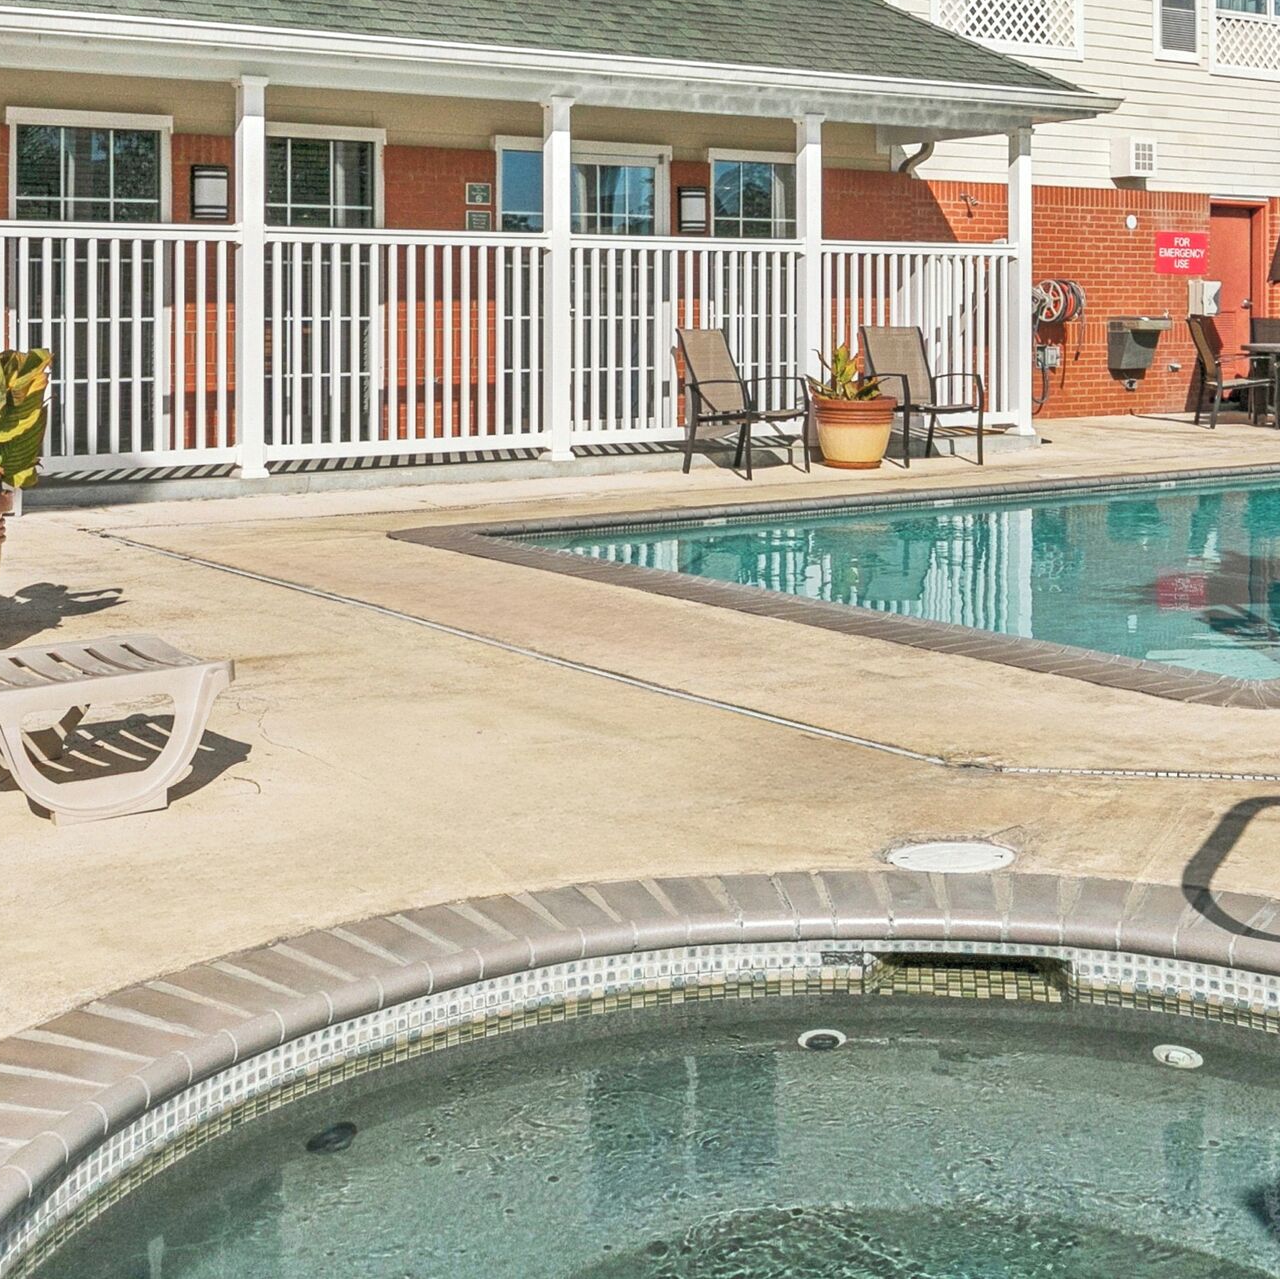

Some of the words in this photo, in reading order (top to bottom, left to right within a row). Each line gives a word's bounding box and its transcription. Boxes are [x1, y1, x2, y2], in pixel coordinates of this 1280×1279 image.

[1174, 237, 1190, 247] FOR
[1159, 247, 1205, 258] EMERGENCY
[1174, 259, 1189, 269] USE
